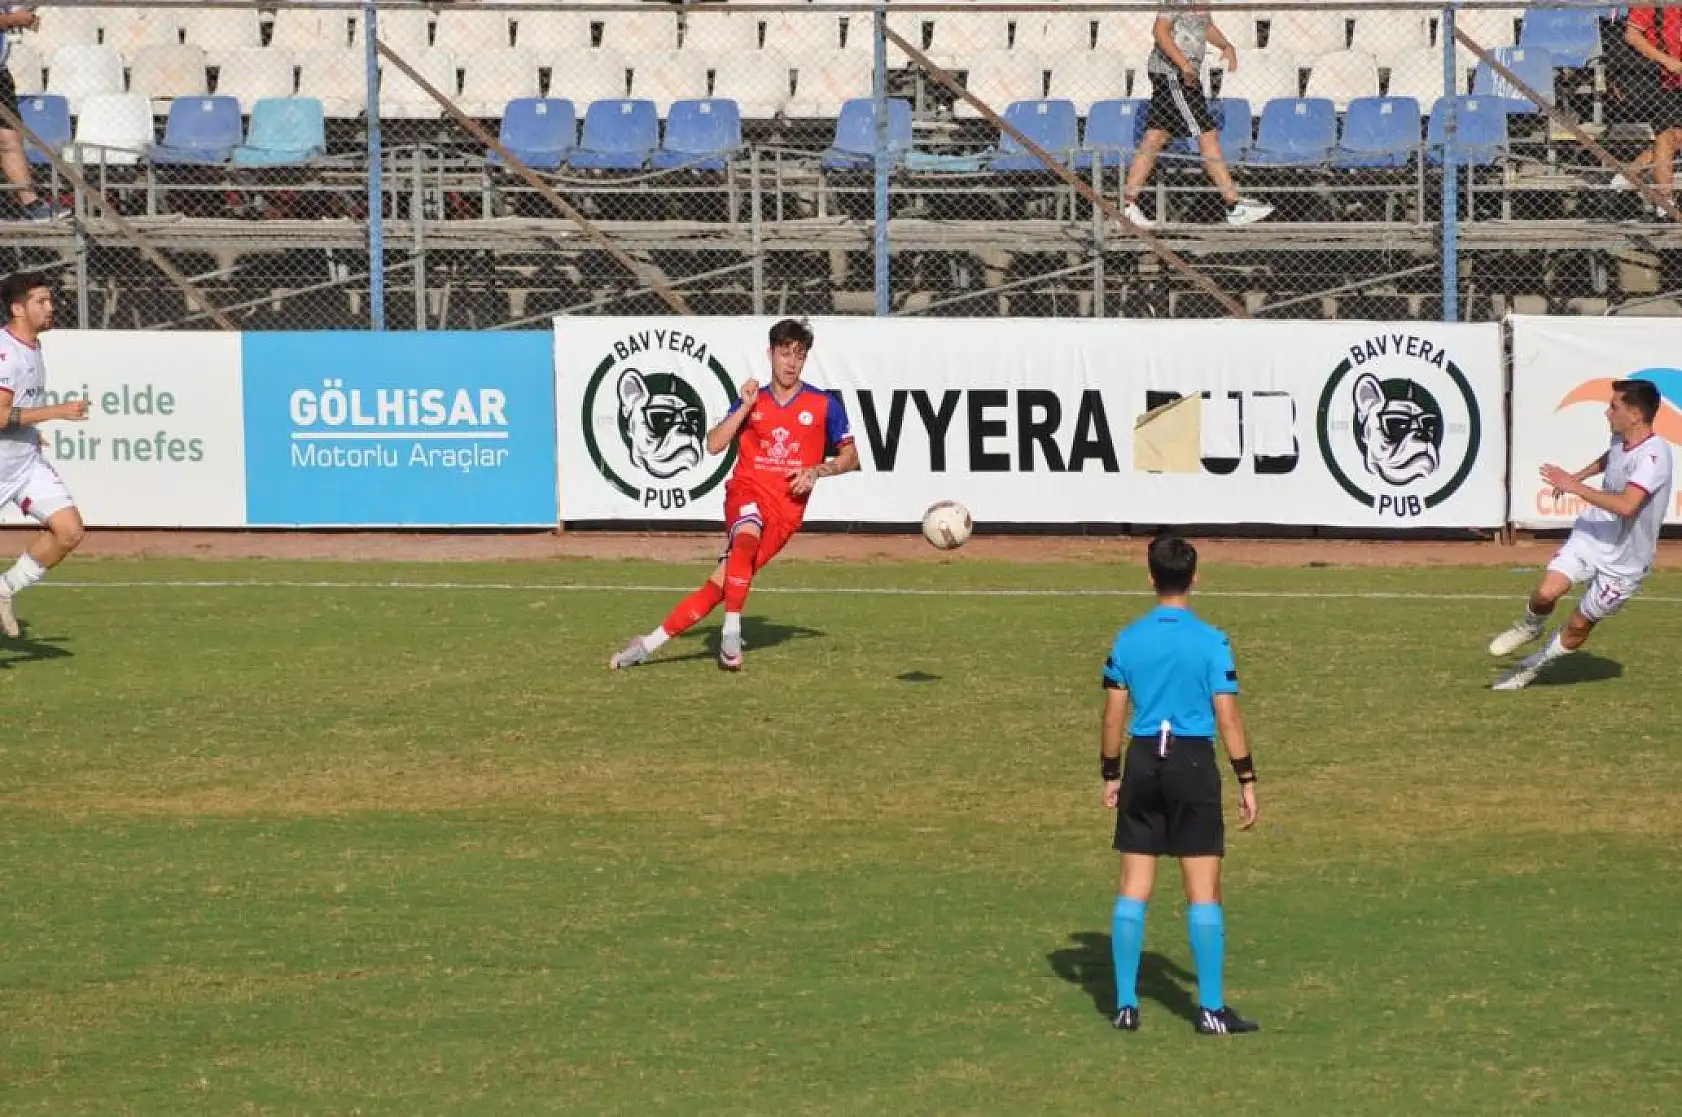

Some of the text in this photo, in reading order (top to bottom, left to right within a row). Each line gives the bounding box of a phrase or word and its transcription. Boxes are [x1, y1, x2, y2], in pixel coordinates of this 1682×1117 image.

[613, 328, 708, 363] BAVYERA
[1350, 333, 1447, 369] BAVYERA
[100, 383, 175, 416] elde
[54, 429, 205, 462] bir nefes
[291, 442, 509, 473] Motorlu Araçlar
[644, 487, 686, 511] PUB
[1378, 494, 1422, 517] PUB
